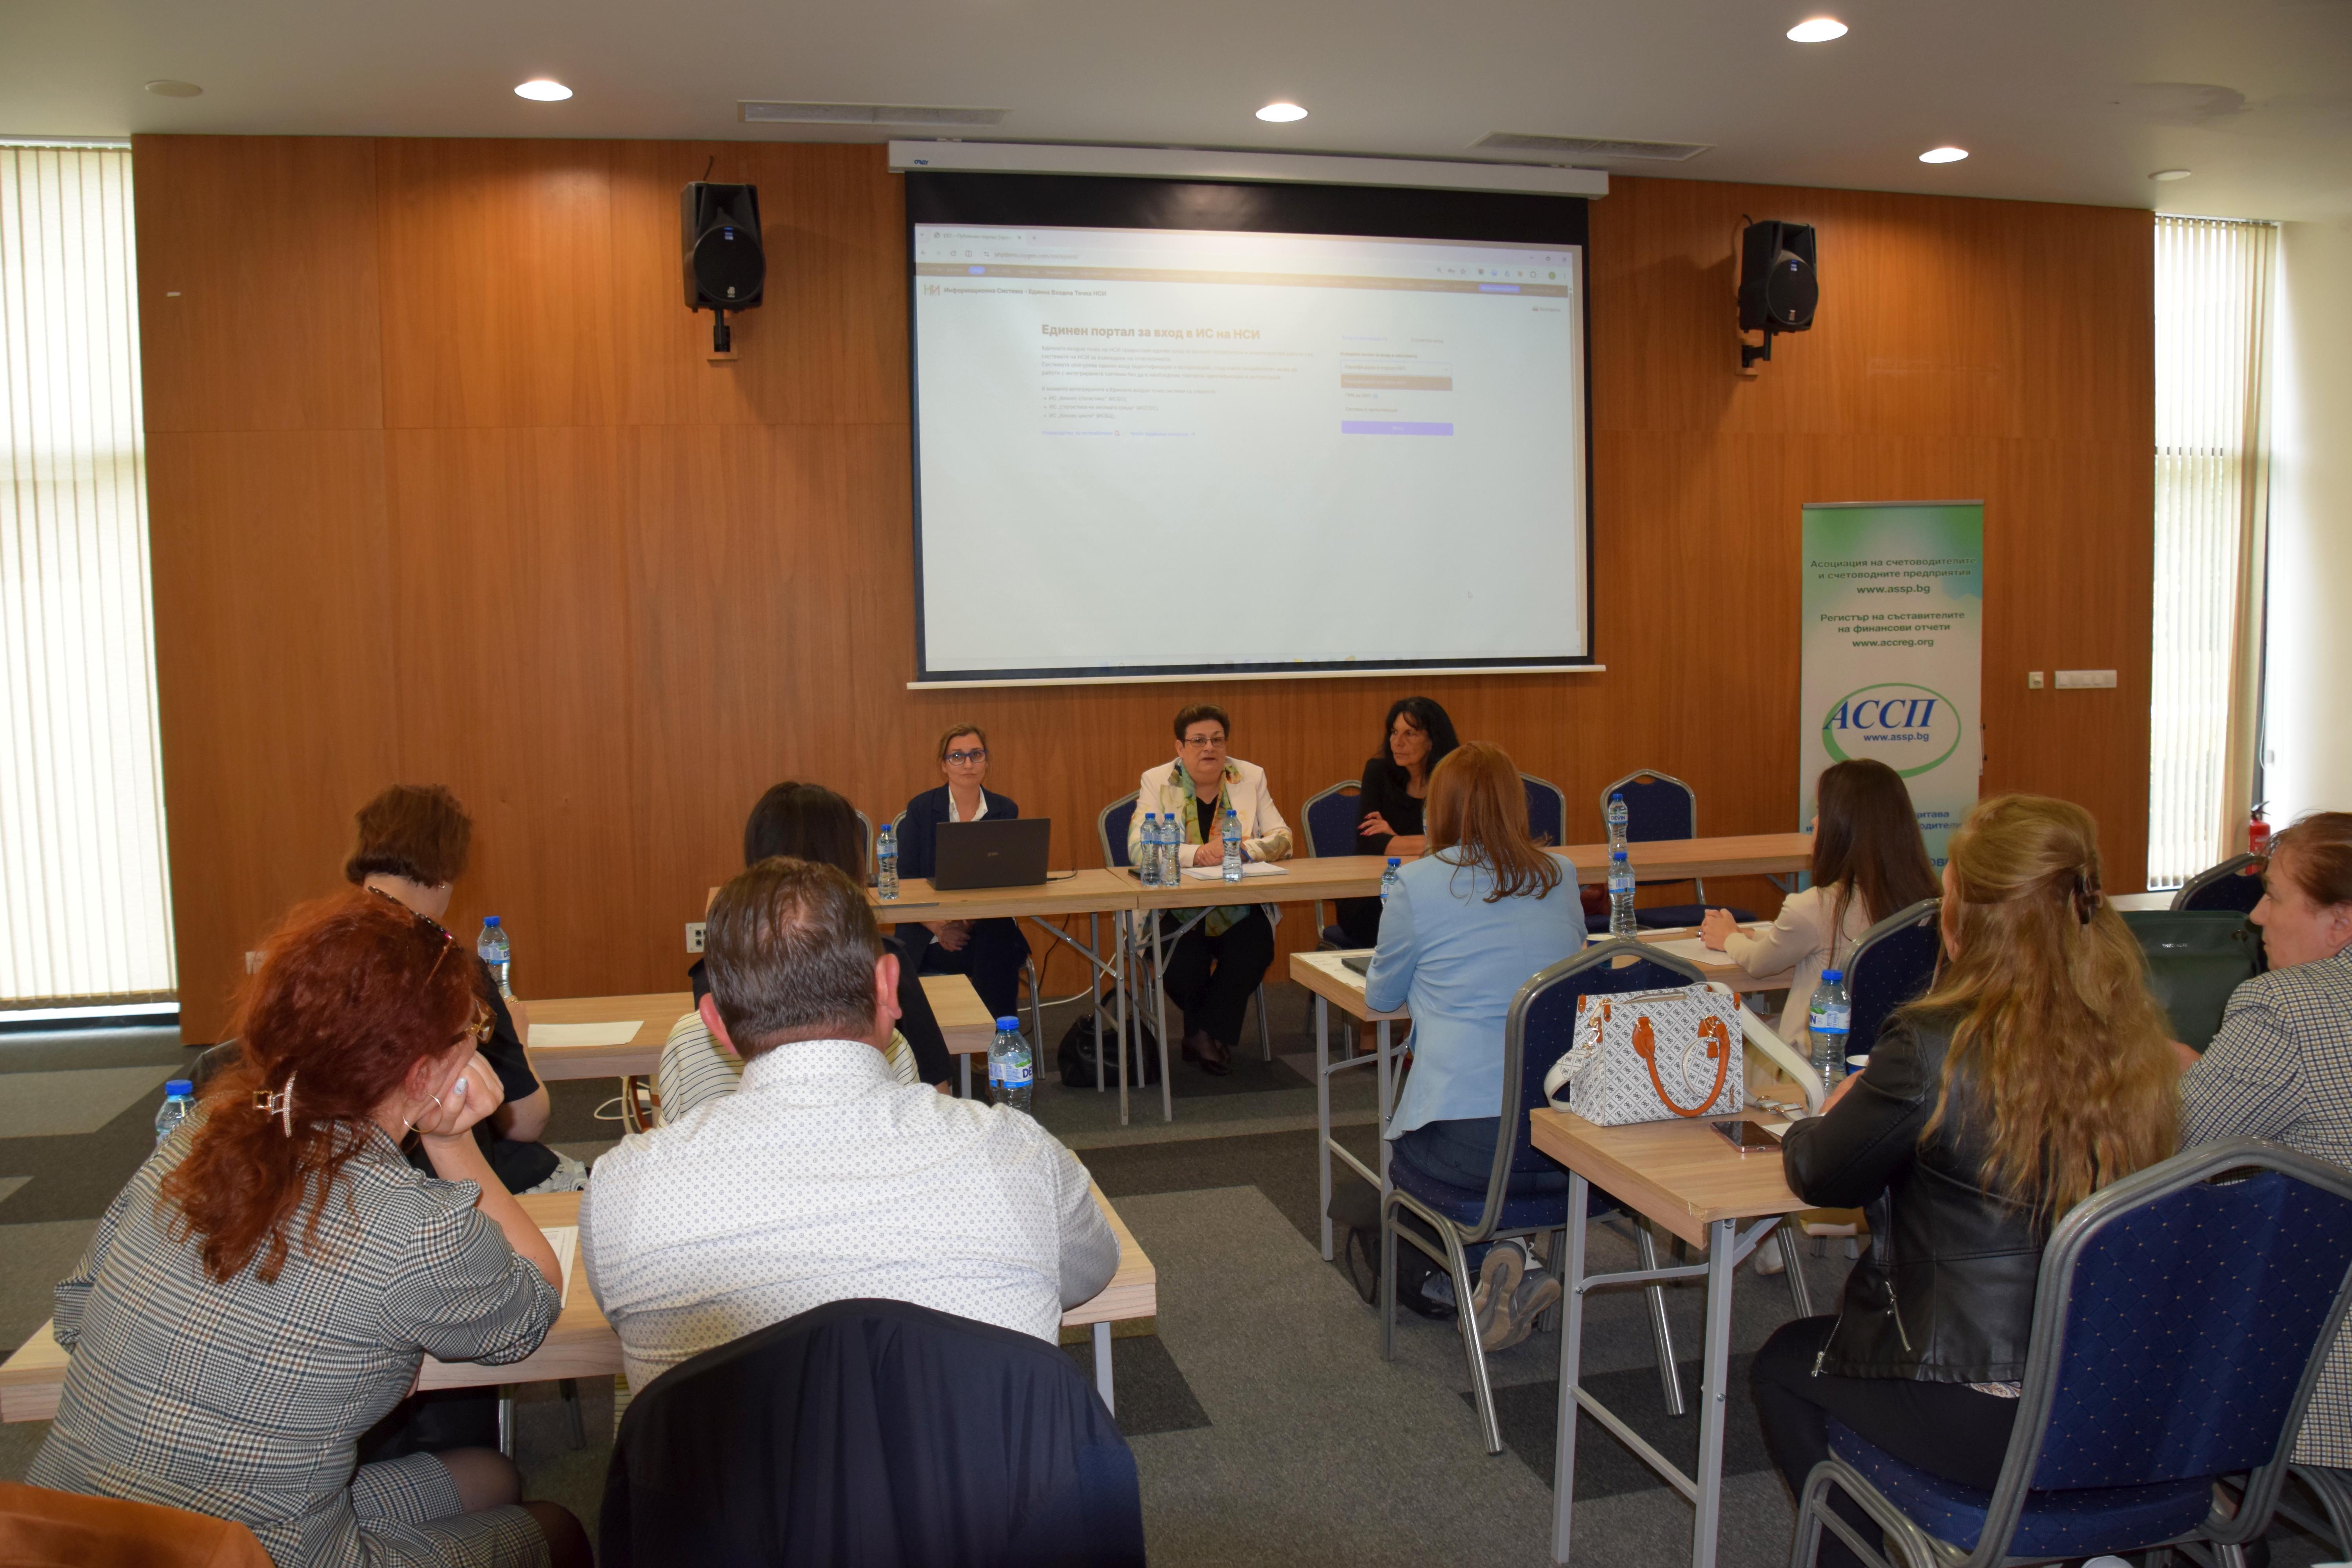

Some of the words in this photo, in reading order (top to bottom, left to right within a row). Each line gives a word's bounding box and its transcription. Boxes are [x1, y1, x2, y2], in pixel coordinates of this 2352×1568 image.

[1042, 324, 1088, 337] Единен
[1092, 327, 1134, 339] портал
[1138, 328, 1151, 337] за
[1154, 328, 1183, 340] вход
[1186, 330, 1193, 338] в
[1196, 328, 1214, 339] ИС
[1217, 330, 1230, 339] на
[1234, 328, 1260, 340] НСИ
[1811, 559, 1867, 568] Асоциация
[1886, 557, 1976, 566] счетоводителите
[1828, 571, 1900, 579] счетоводните
[1904, 569, 1971, 578] предприятия
[1857, 584, 1931, 594] www.assp.bg
[1820, 613, 1869, 622] Регистър
[1853, 624, 1911, 634] финансови
[1852, 639, 1935, 647] www.accreg.org
[1823, 699, 1939, 730] АССП
[1863, 732, 1929, 742] www.assp.bg
